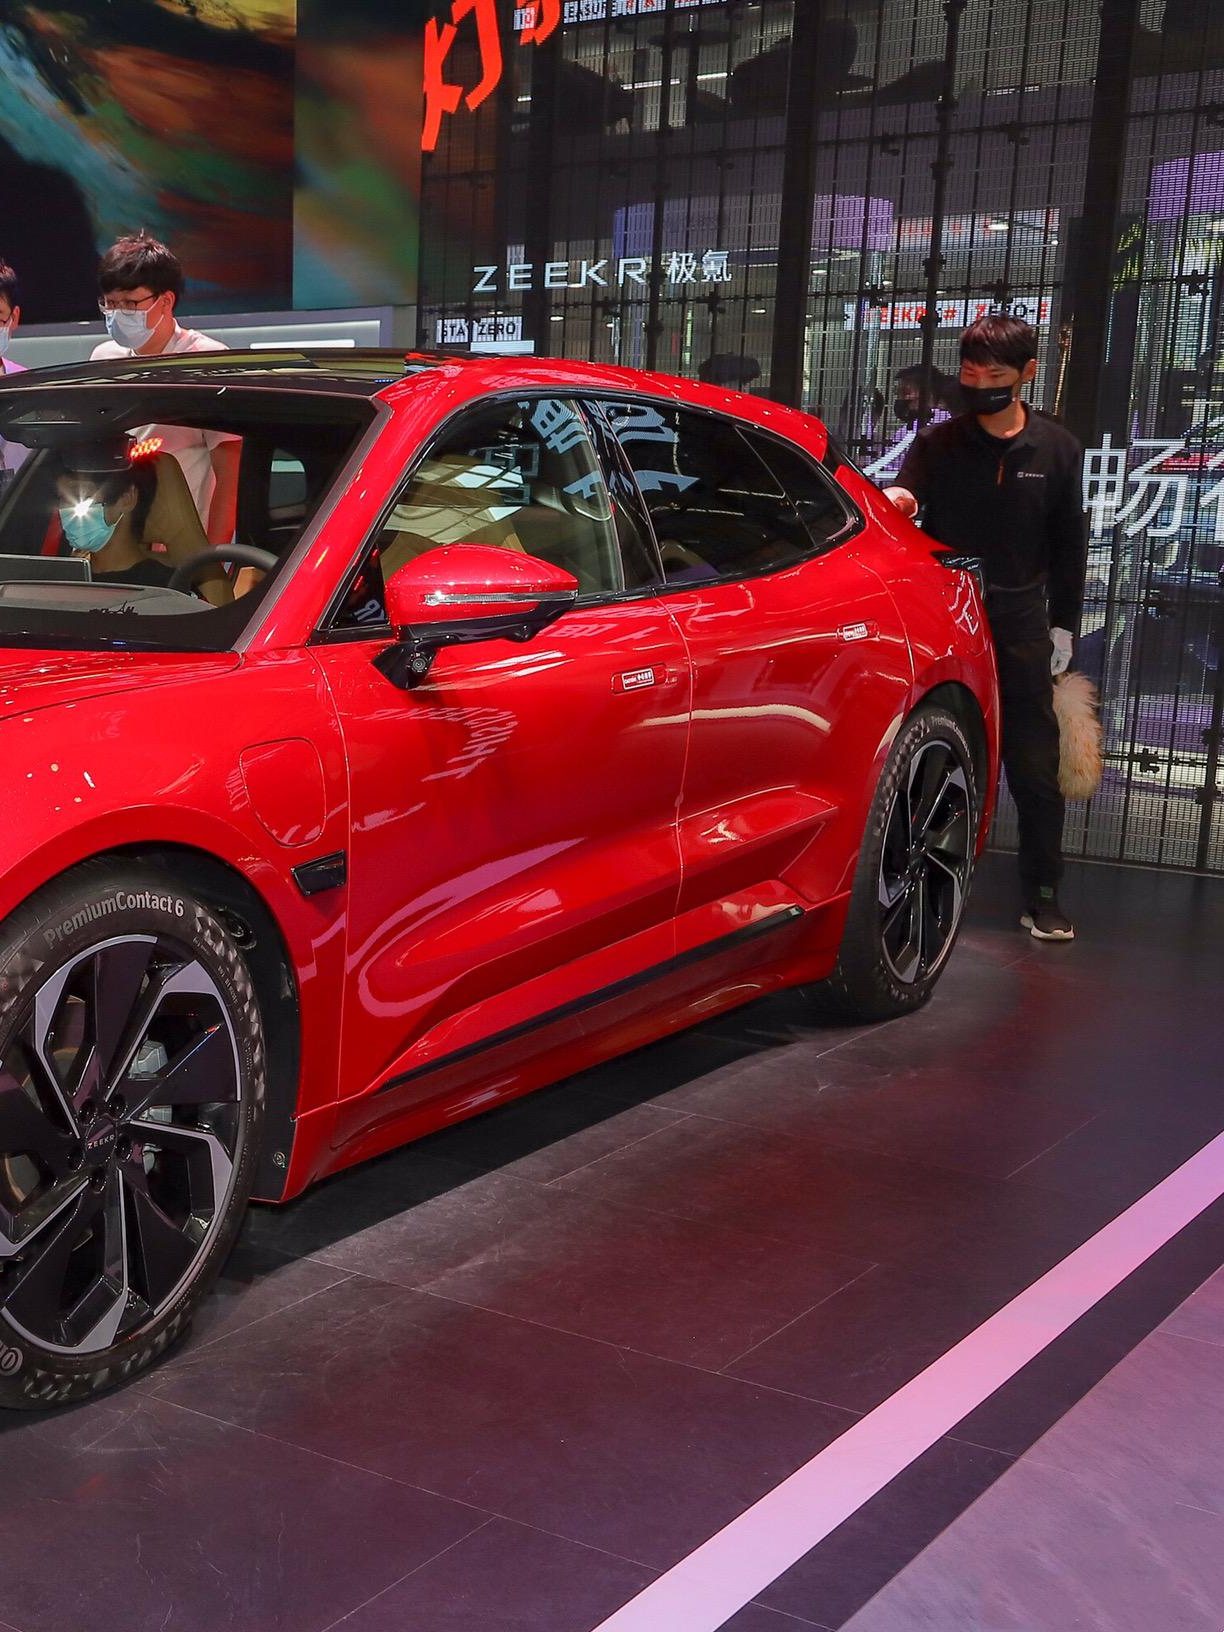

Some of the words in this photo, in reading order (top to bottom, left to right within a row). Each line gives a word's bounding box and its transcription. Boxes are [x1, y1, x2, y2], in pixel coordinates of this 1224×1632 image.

[472, 257, 648, 293] ZEEKR
[666, 248, 733, 285] 极氪
[1081, 432, 1224, 541] 畅
[42, 891, 173, 949] PremiumContact
[175, 899, 184, 917] 6
[87, 1134, 115, 1150] ZEEKR
